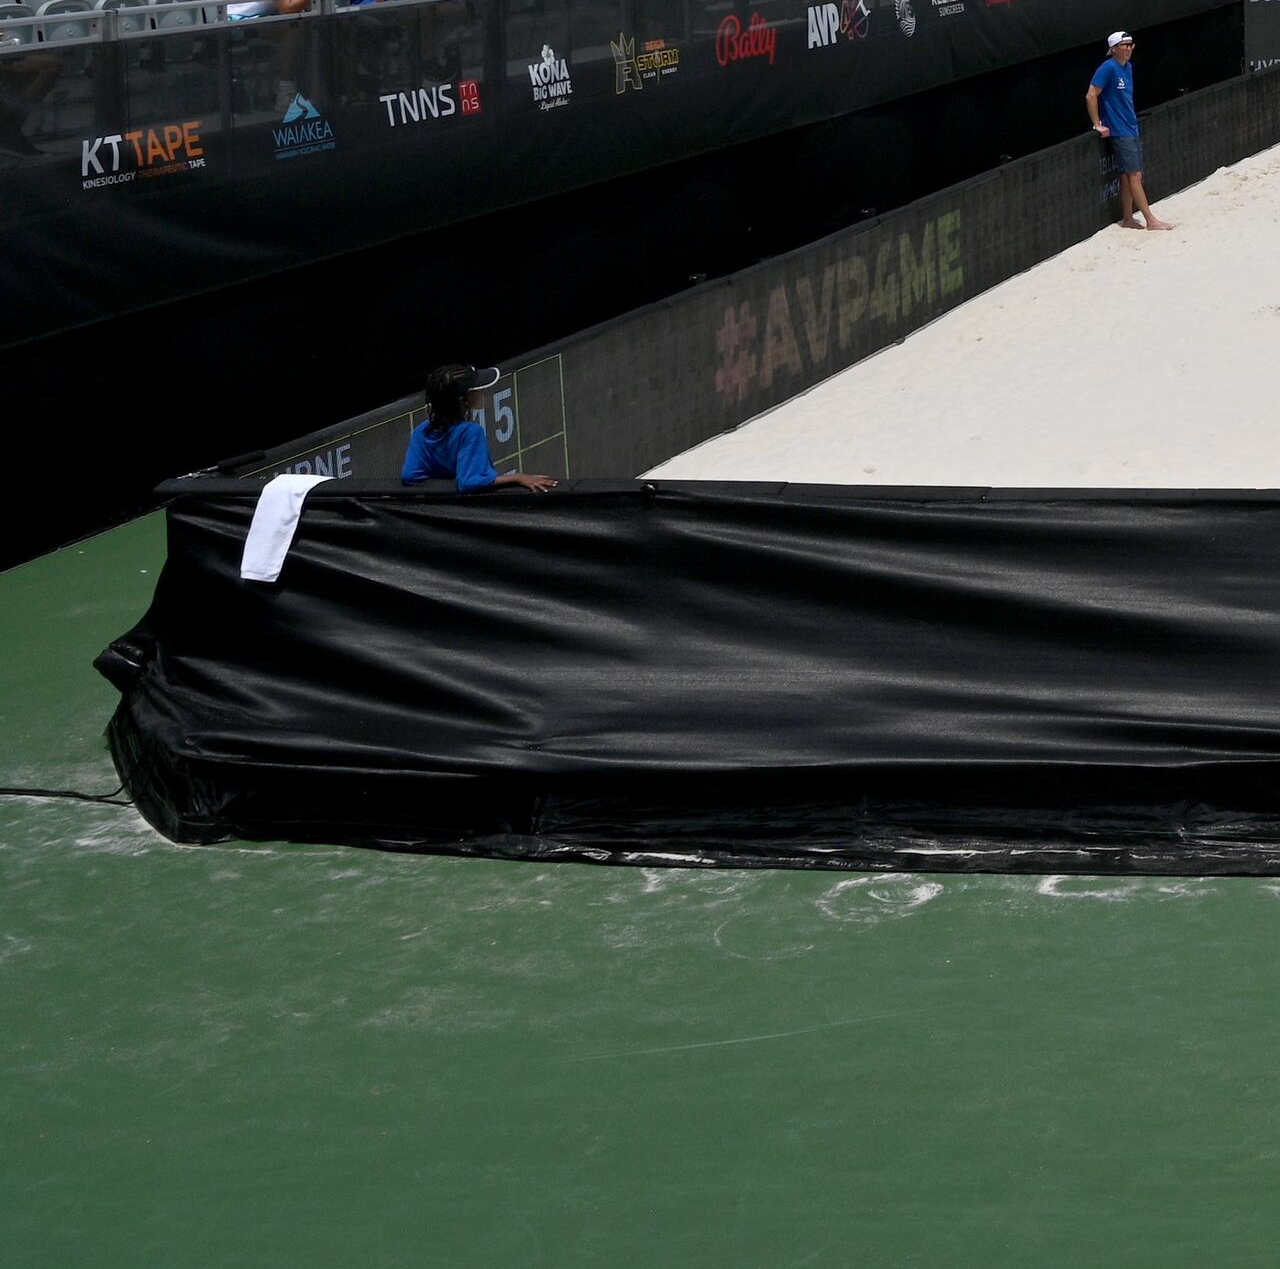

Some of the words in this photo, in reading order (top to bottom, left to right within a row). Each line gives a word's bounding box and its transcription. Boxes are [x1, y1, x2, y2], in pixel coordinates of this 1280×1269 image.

[716, 12, 778, 67] Bally
[807, 2, 840, 50] AVP
[528, 58, 570, 86] KONA
[637, 49, 680, 71] STORM
[379, 84, 456, 127] TNNS
[533, 86, 548, 101] BIG
[548, 80, 573, 98] WAVE
[81, 134, 123, 177] KT
[125, 121, 204, 167] TAPE
[272, 120, 334, 147] WAIAKEA
[82, 171, 136, 190] KINESIOLOGY
[188, 158, 207, 170] TAPE
[715, 209, 965, 407] #AVP4ME
